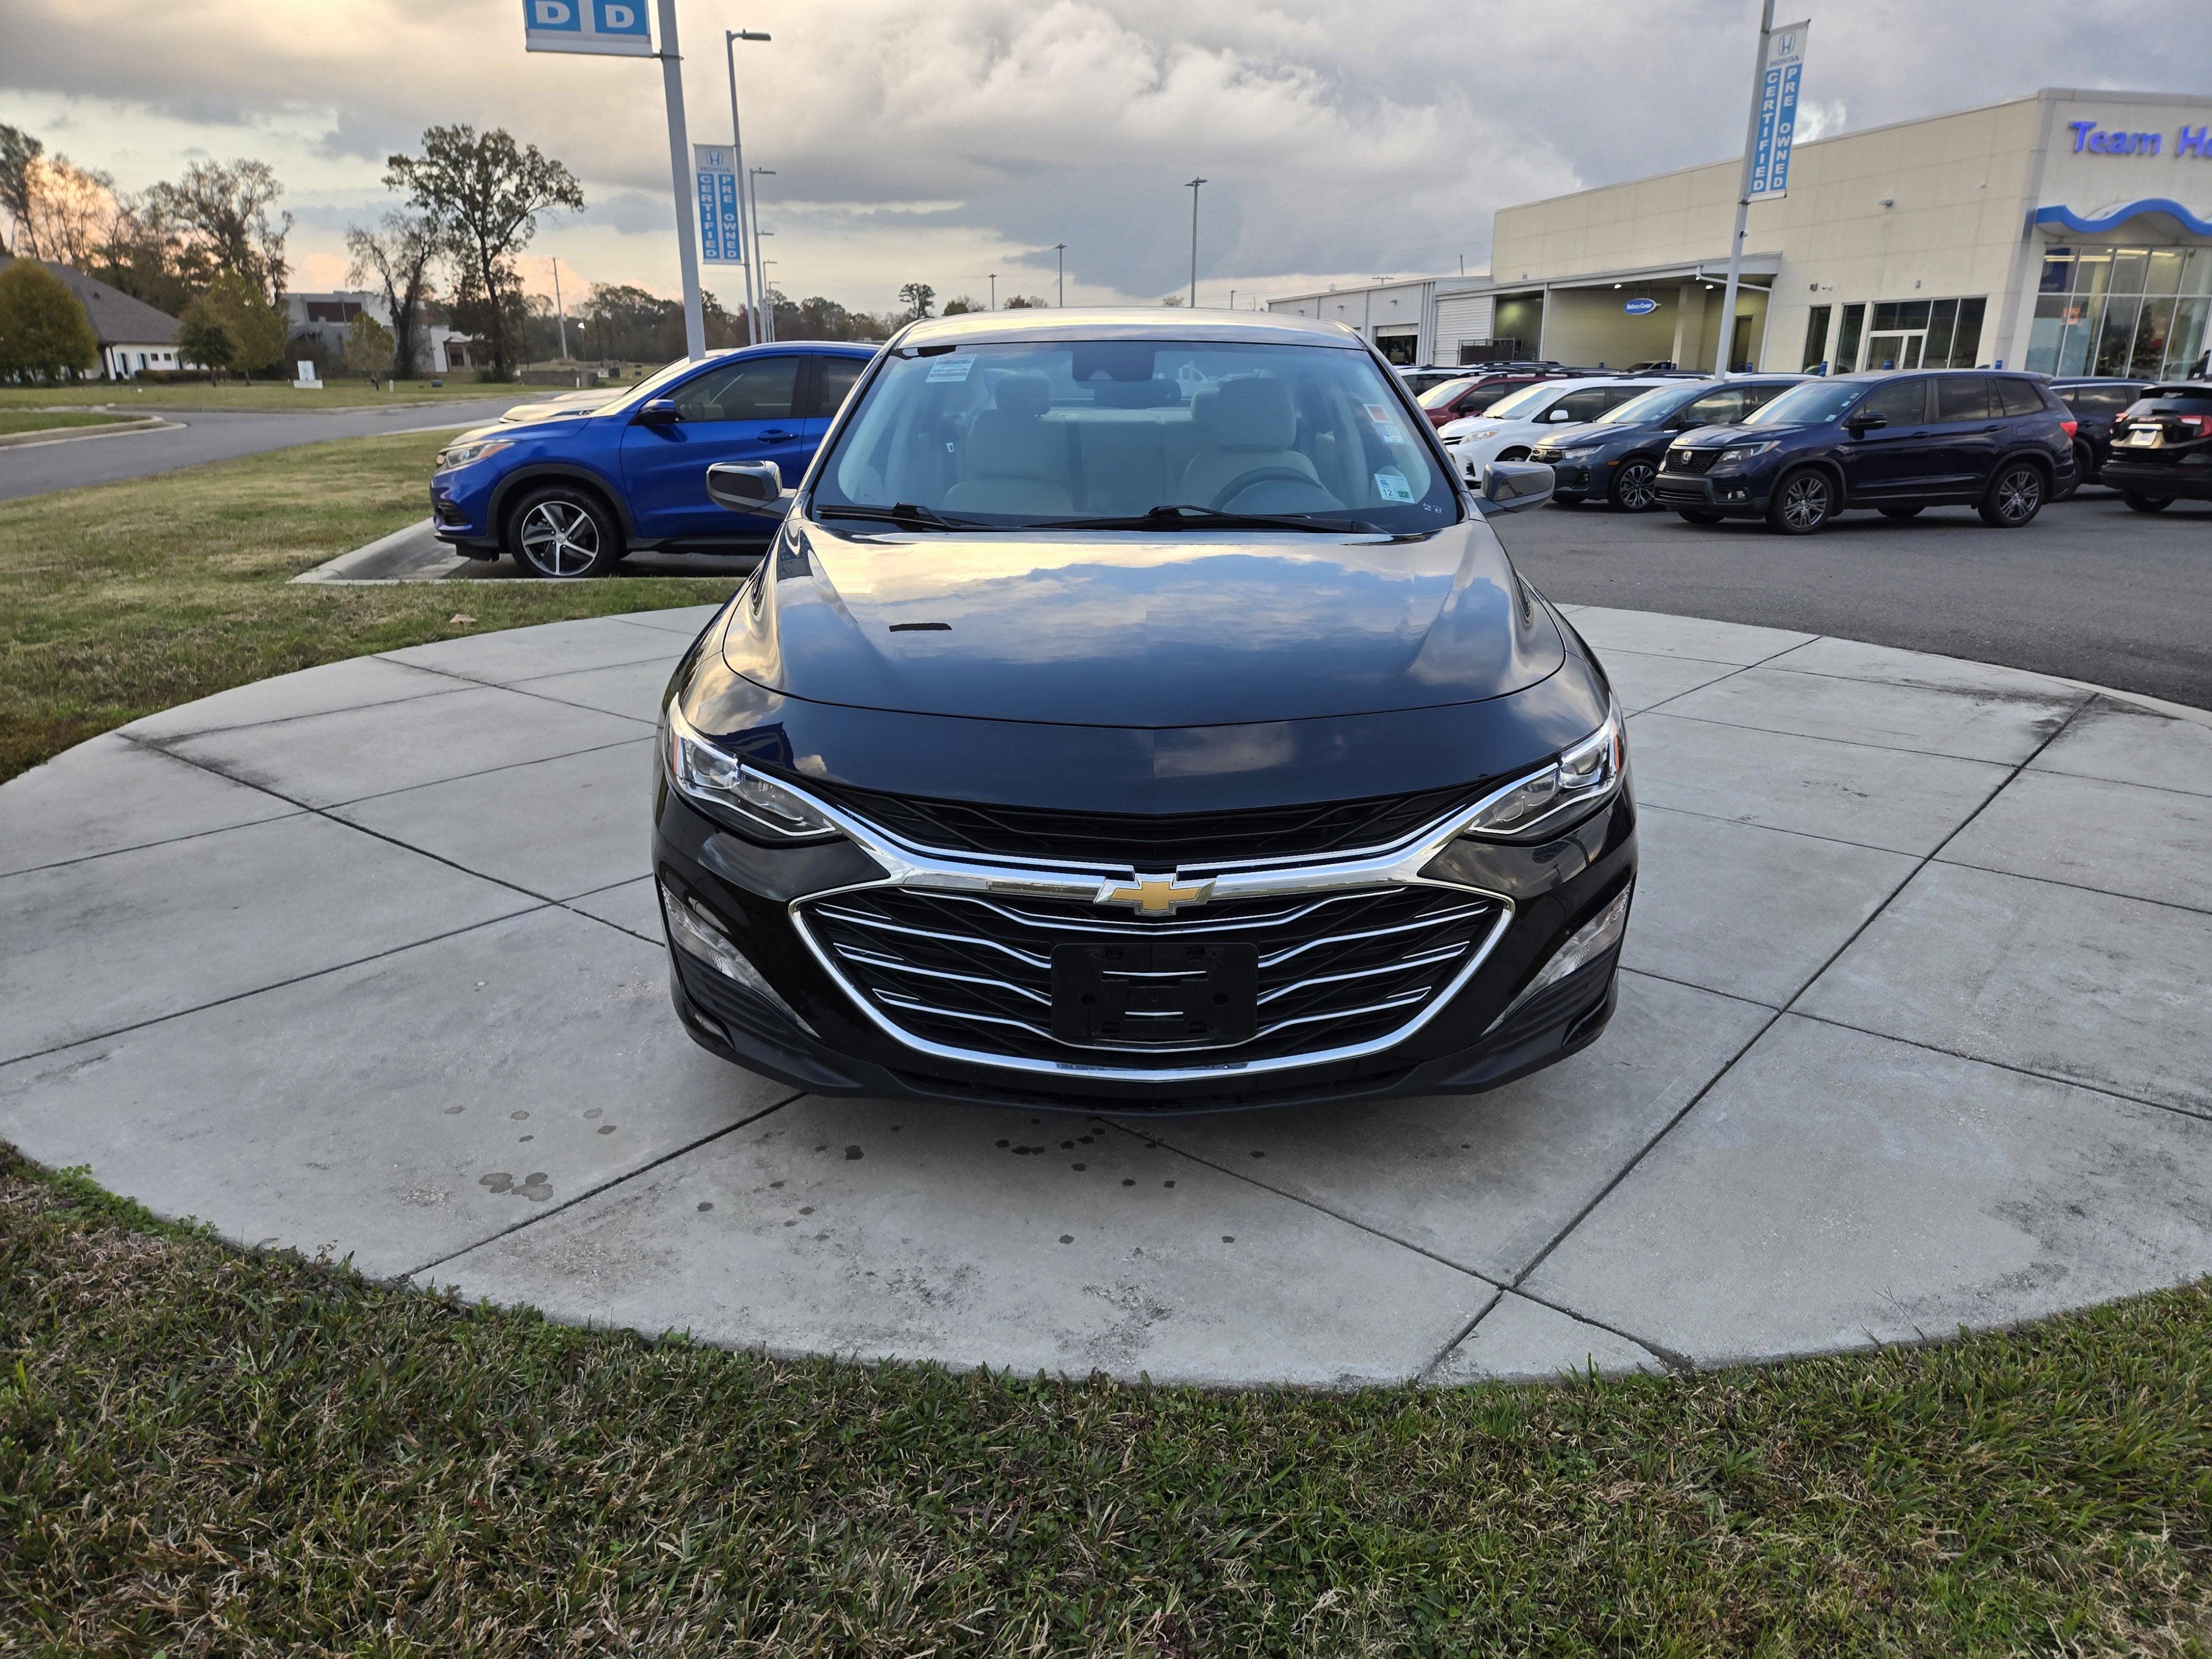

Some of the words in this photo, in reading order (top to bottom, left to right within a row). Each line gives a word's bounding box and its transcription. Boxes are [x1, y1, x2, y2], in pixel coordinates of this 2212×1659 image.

[1770, 55, 1799, 66] HONDA
[1783, 67, 1798, 107] PRE
[1753, 72, 1778, 191] CERTIFIED
[2069, 121, 2162, 155] Team
[1773, 122, 1791, 189] OWNED
[722, 176, 733, 203] PRE
[700, 175, 717, 257] CERTIFIED
[723, 213, 737, 258] OWNED
